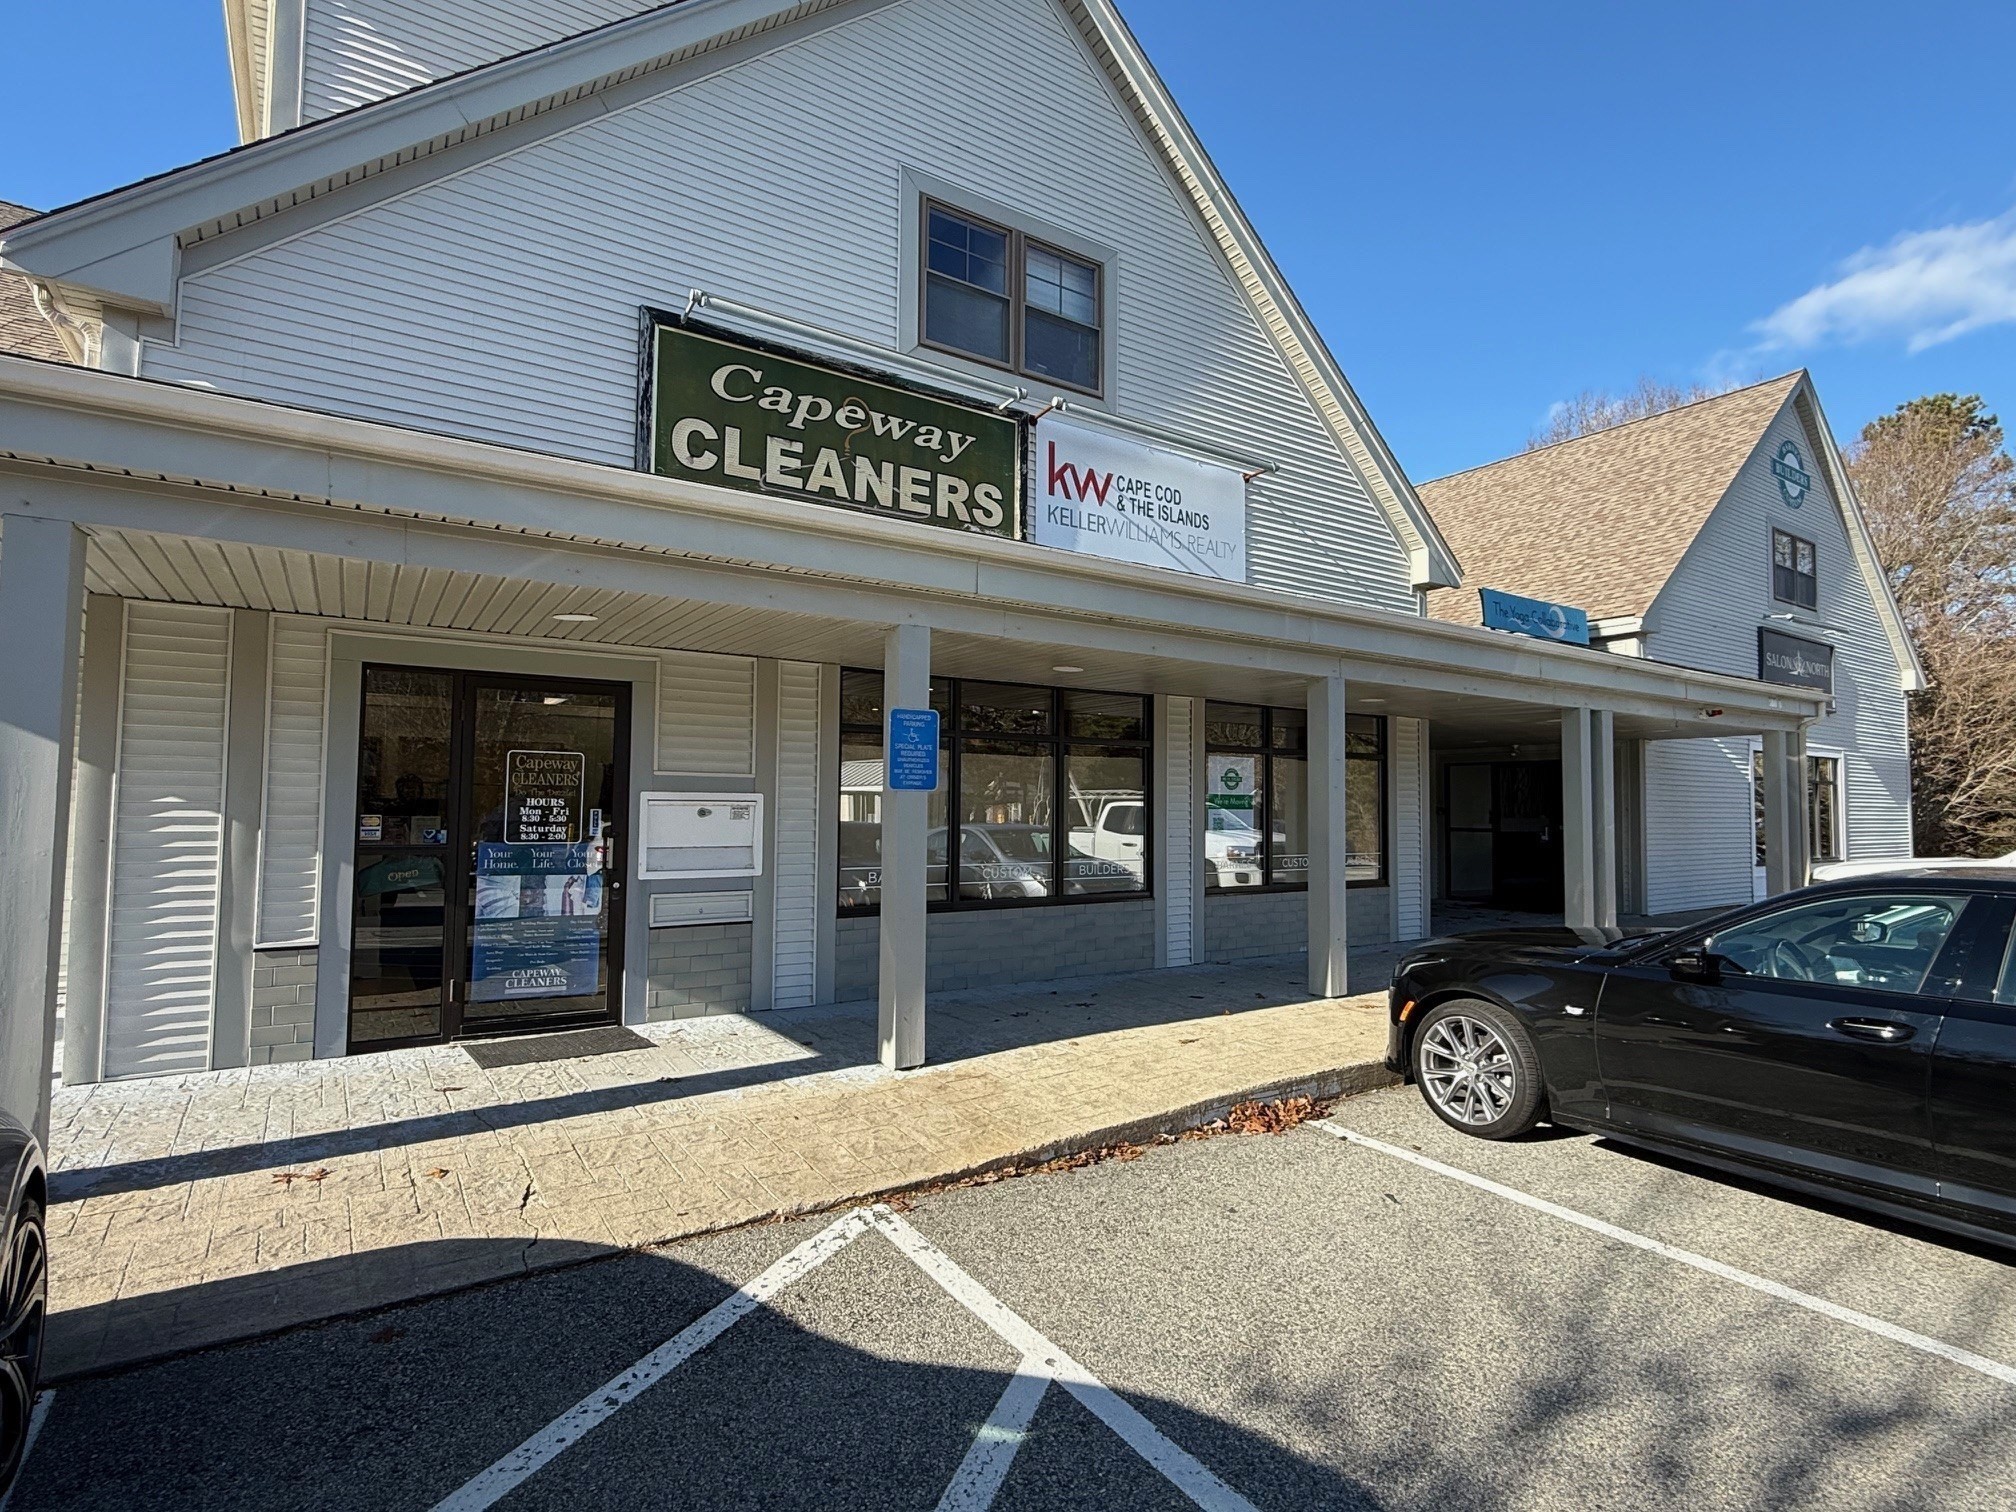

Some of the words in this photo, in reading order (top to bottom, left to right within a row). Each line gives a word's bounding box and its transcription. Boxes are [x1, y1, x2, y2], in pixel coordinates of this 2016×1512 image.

[710, 364, 978, 463] Capeway
[671, 417, 1004, 527] CLEANERS
[1048, 440, 1113, 506] kw
[1116, 475, 1151, 498] CAPE
[1155, 485, 1181, 505] COD
[1117, 494, 1126, 512] &
[1129, 497, 1154, 519] THE
[1158, 504, 1209, 531] ISLANDS
[1187, 534, 1237, 560] REALTY
[1492, 601, 1509, 618] The
[1509, 605, 1530, 625] Yoga
[1766, 652, 1792, 670] SALON
[1805, 661, 1830, 678] NORTH
[903, 720, 925, 728] PARKING
[516, 755, 578, 773] Capeway
[512, 772, 579, 787] CLEANERS
[526, 798, 565, 807] HOURS
[519, 807, 542, 815] Mon
[552, 807, 570, 815] Fri
[519, 824, 567, 834] Saturday
[487, 848, 513, 858] Your
[530, 848, 555, 858] Your
[484, 859, 519, 869] Home.
[532, 858, 555, 869] Life.
[1282, 857, 1308, 868] CUSTO
[388, 869, 419, 882] Open
[982, 866, 1032, 879] CUSTOM
[1079, 863, 1130, 876] BUILDERS
[512, 968, 562, 978] CAPEWAY
[505, 976, 568, 988] CLEANERS
